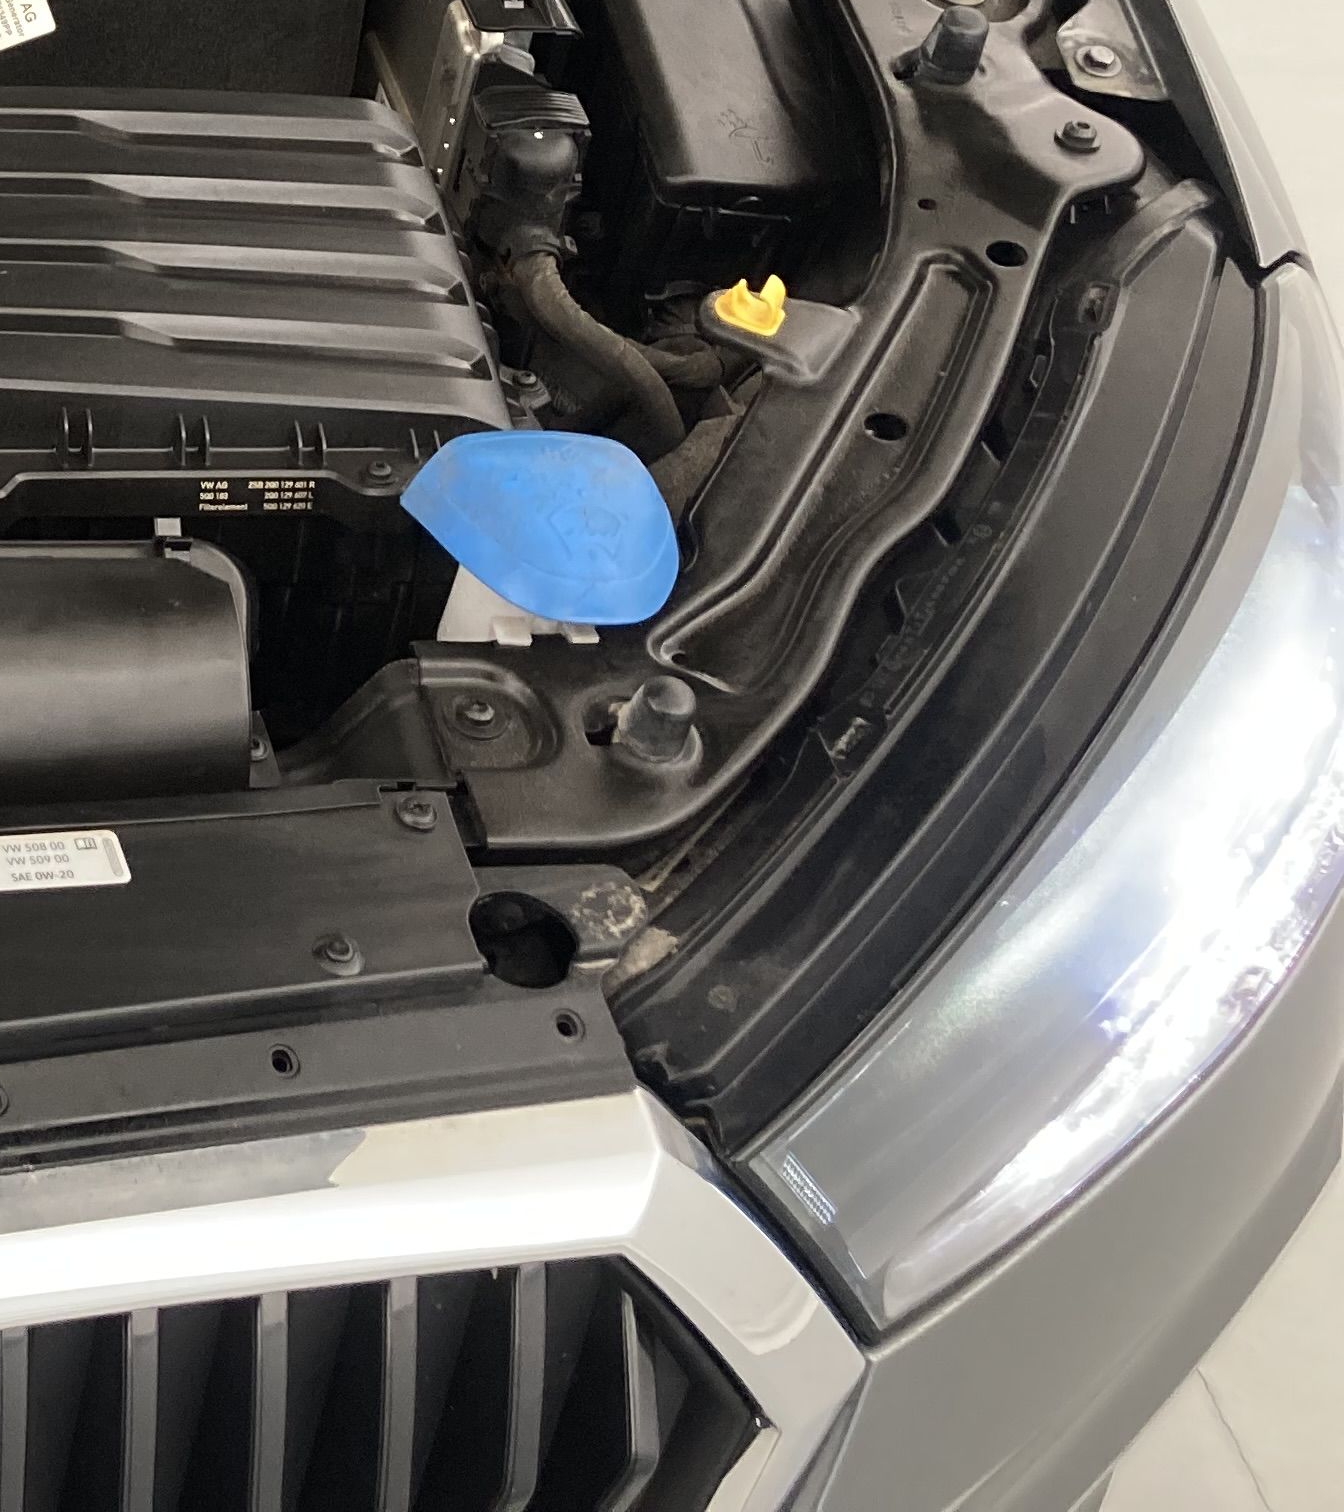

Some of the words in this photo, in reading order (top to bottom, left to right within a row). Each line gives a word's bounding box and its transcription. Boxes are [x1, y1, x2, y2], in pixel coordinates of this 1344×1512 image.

[20, 3, 37, 23] AG
[201, 481, 214, 489] VW
[216, 481, 229, 489] AG
[281, 481, 293, 489] 129
[309, 481, 315, 489] R
[281, 491, 293, 499] 129
[308, 491, 314, 499] L
[199, 503, 248, 511] Filterelement
[280, 502, 291, 510] 129
[2, 844, 21, 853] VW
[26, 842, 45, 852] 508
[49, 841, 65, 851] 00
[6, 857, 26, 866] VW
[30, 855, 51, 865] 509
[54, 854, 70, 864] 00
[11, 872, 33, 882] SAE
[35, 870, 75, 881] 0W-20
